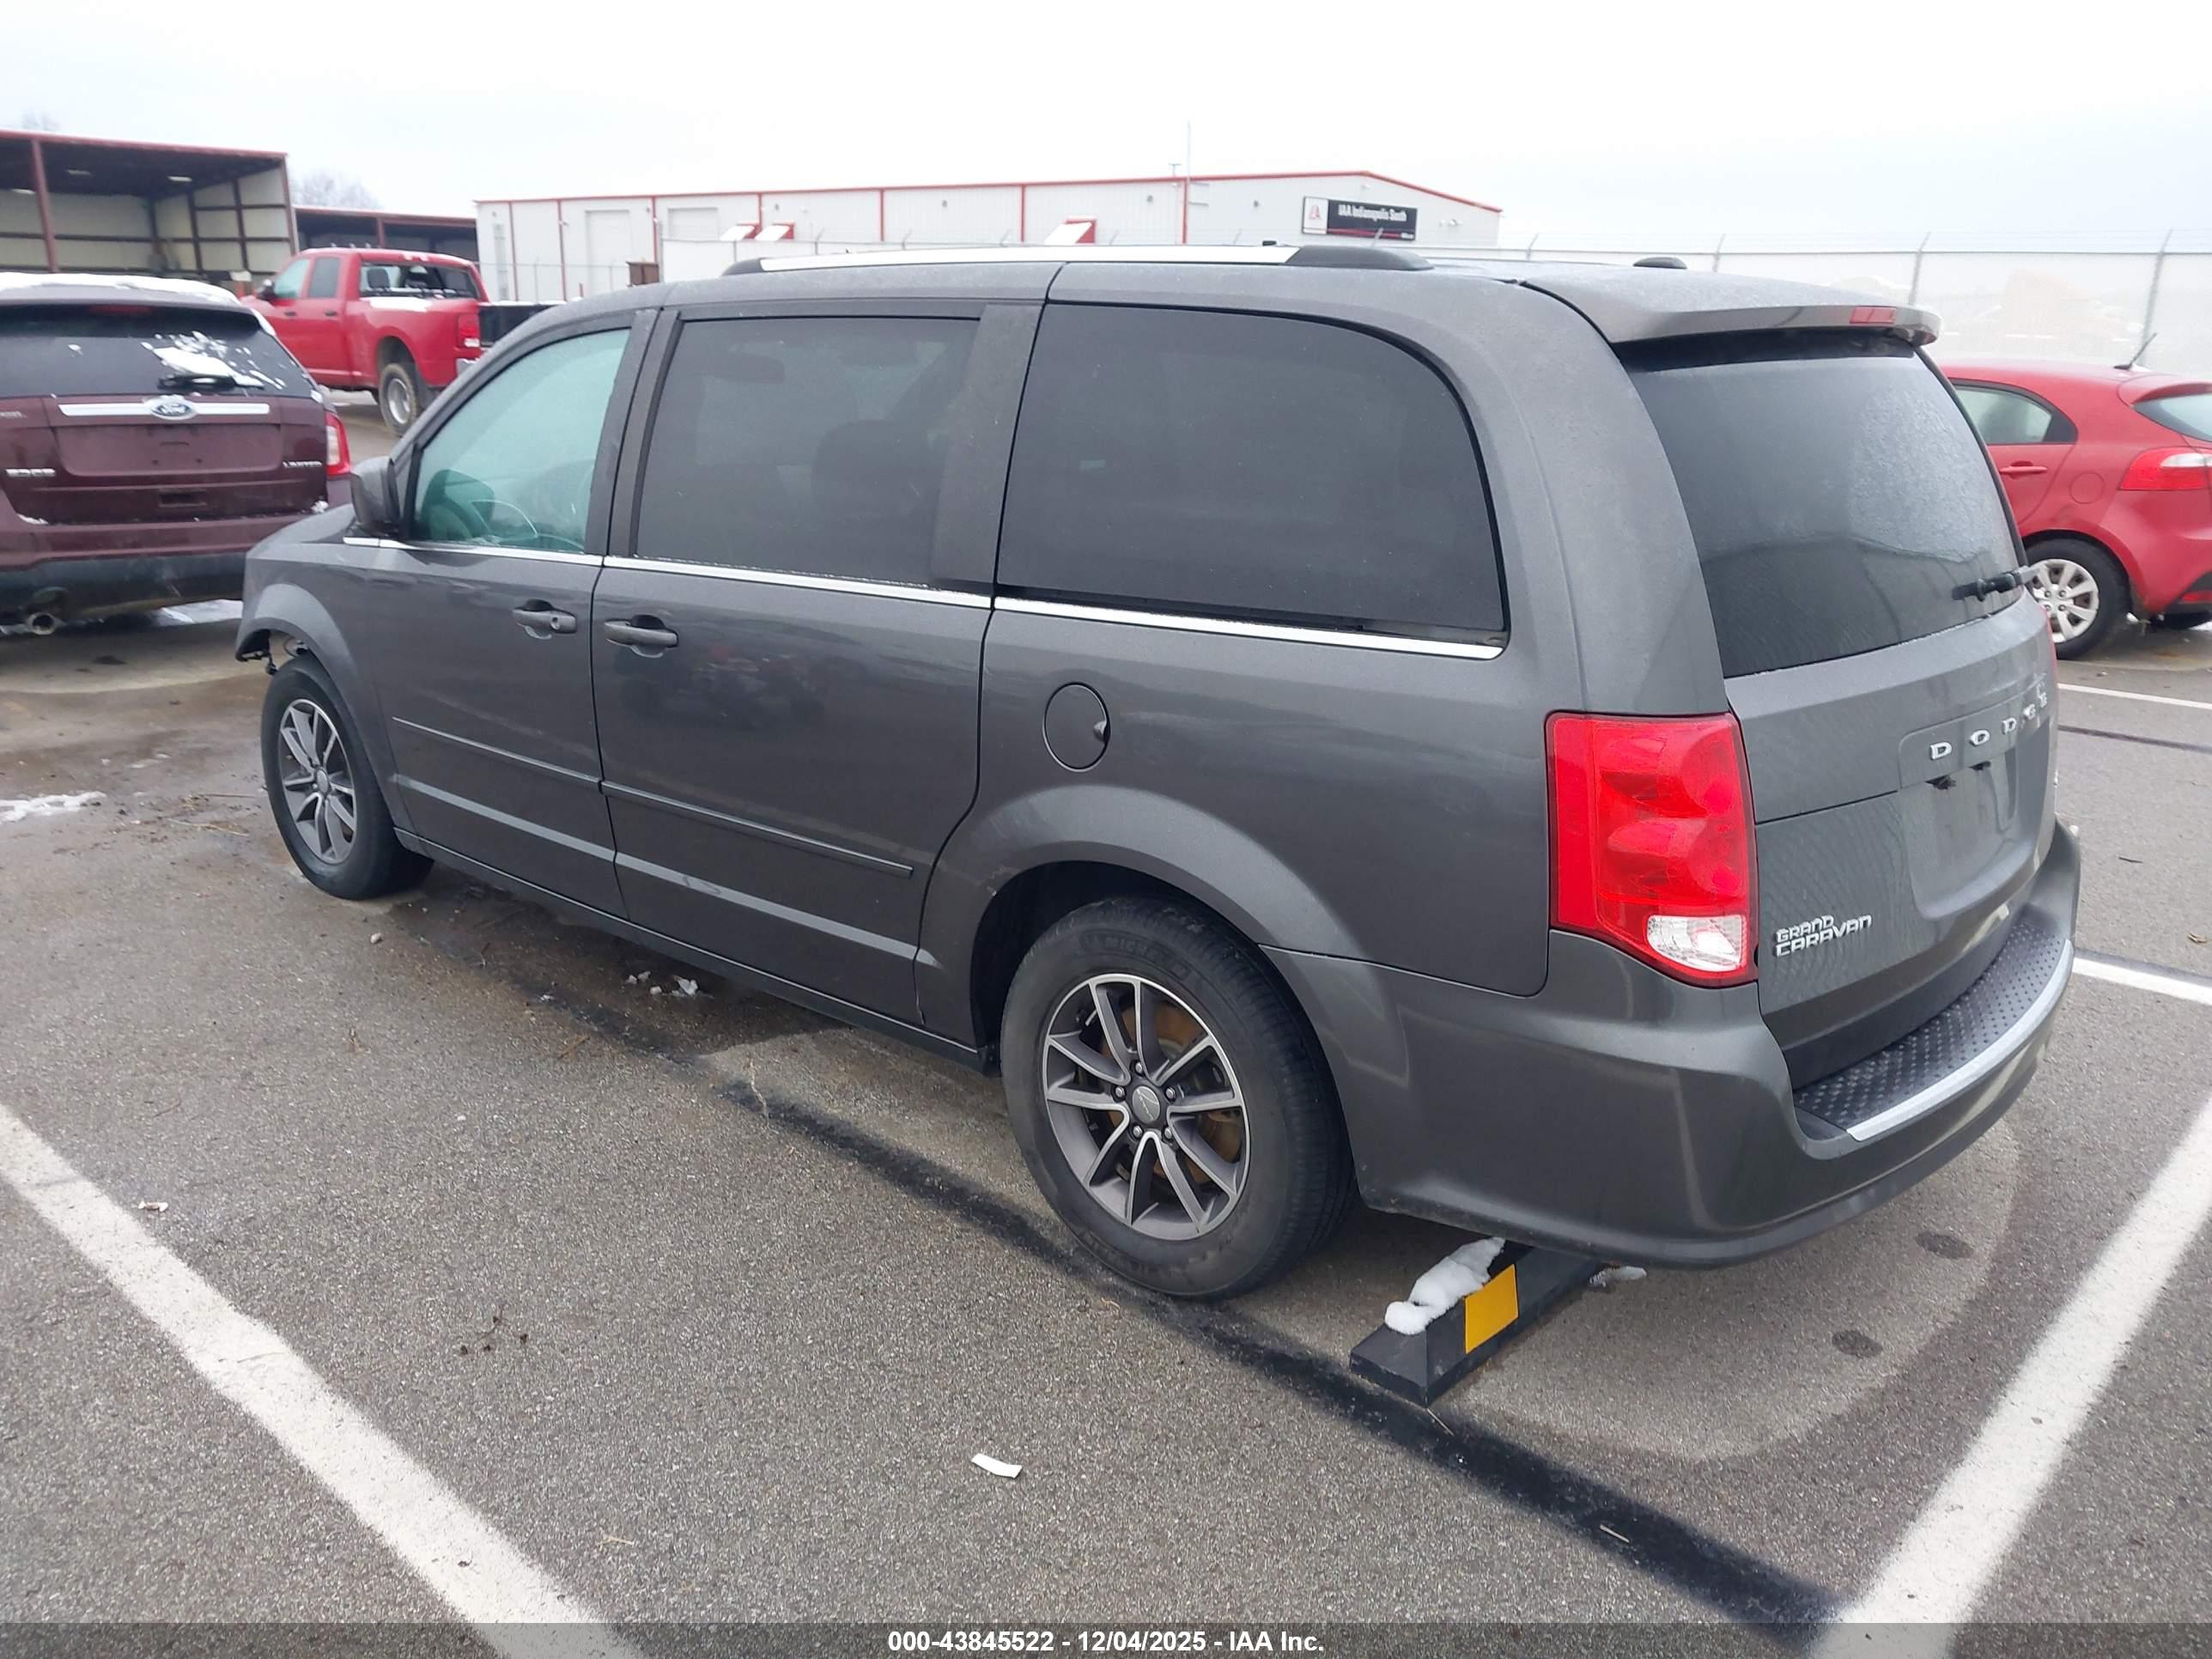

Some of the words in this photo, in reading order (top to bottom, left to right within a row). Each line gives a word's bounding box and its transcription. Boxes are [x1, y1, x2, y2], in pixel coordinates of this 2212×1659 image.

[1929, 691, 2048, 761] DODGE
[1774, 914, 1873, 957] CARAVAN
[1775, 914, 1835, 943] GRAND
